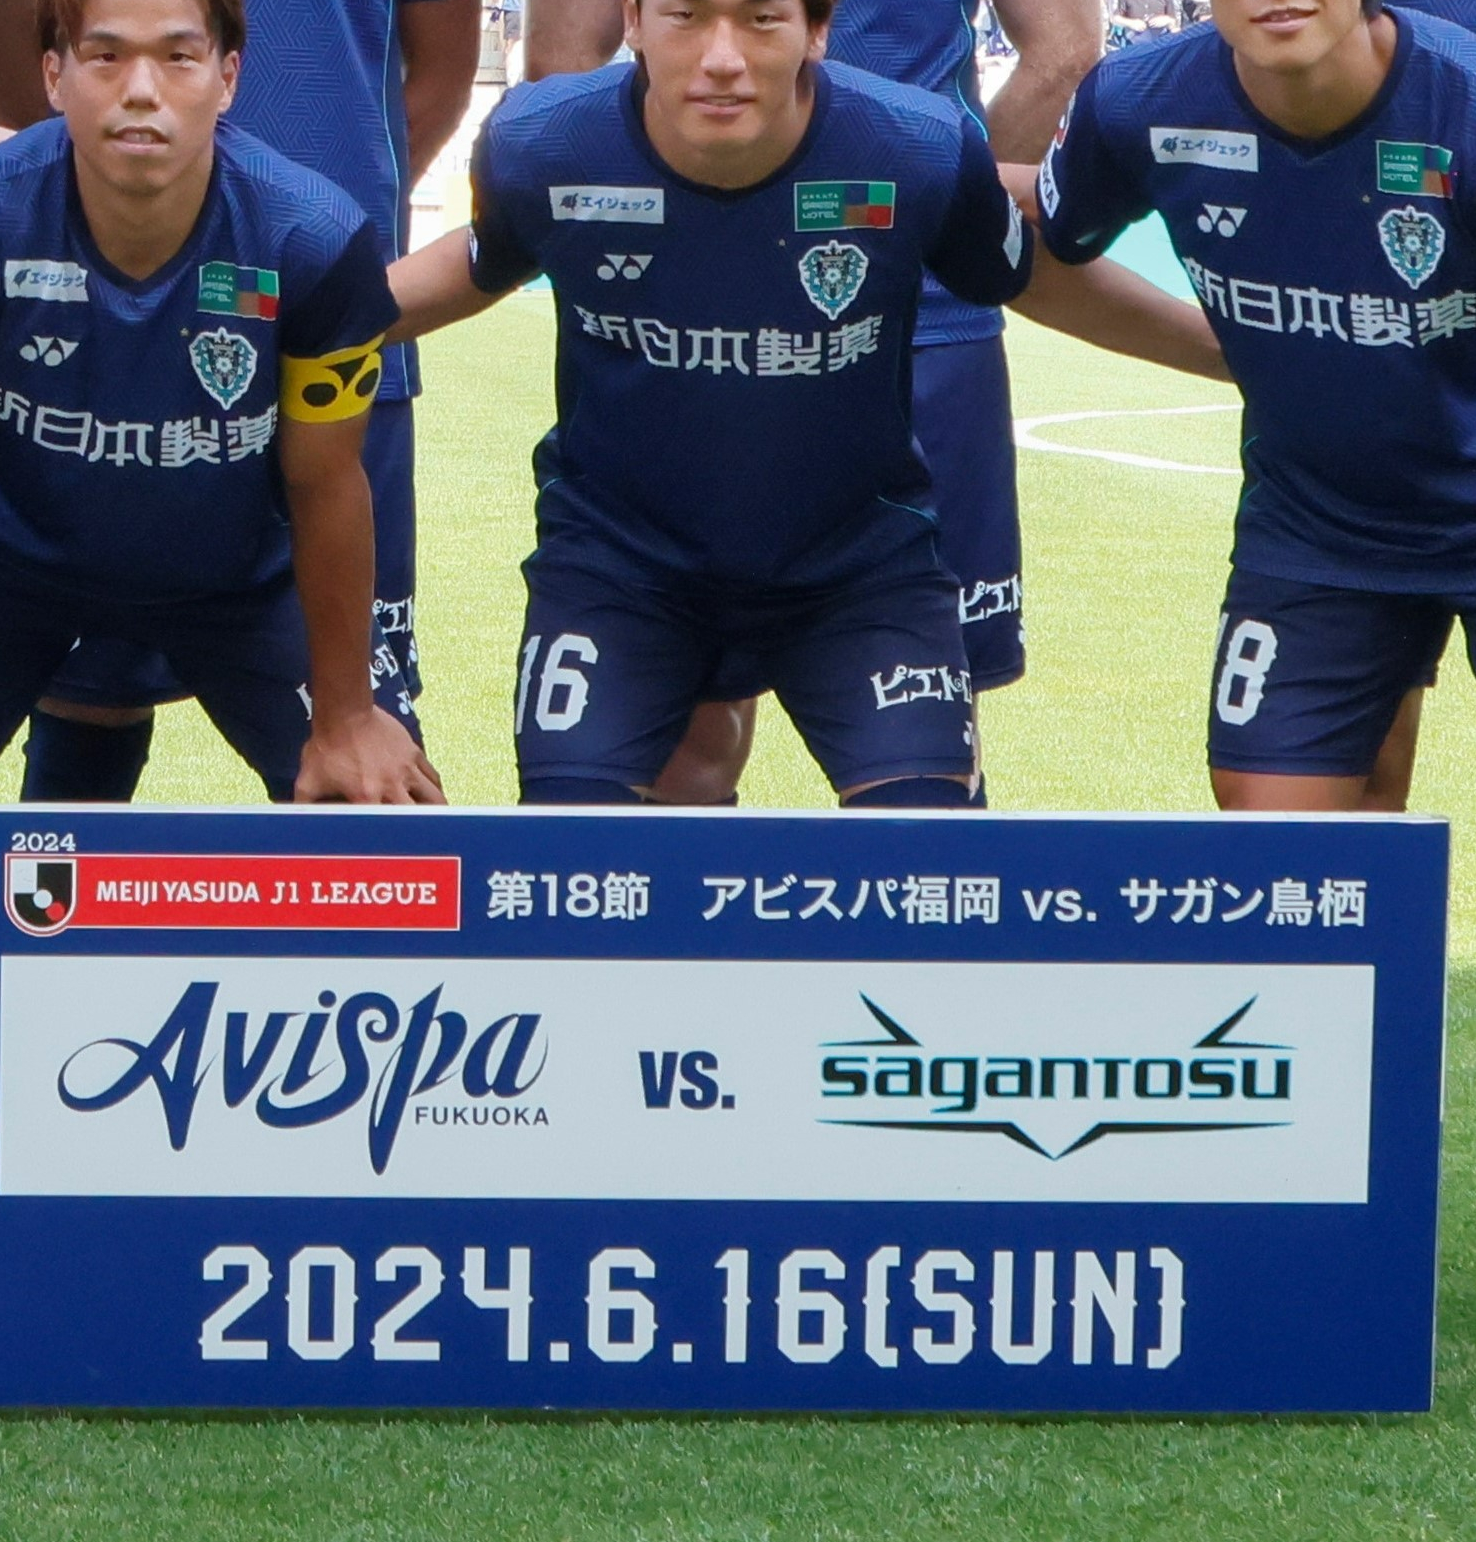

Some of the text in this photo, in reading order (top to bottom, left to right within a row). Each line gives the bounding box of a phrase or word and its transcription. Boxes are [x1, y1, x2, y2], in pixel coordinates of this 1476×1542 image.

[1180, 138, 1251, 158] エイジェック
[581, 196, 657, 213] エイジェック
[574, 304, 884, 377] 新日本製薬
[515, 633, 599, 736] 16
[10, 832, 76, 852] 2024
[96, 880, 437, 906] MEIJI YASUDA J1 LEAGUE
[485, 870, 1368, 927] 第18節 アビスパ福岡 vs. サガン鳥栖
[413, 1105, 551, 1127] FUKUOKA
[199, 1246, 1188, 1371] 2024.6.16(SUN)
